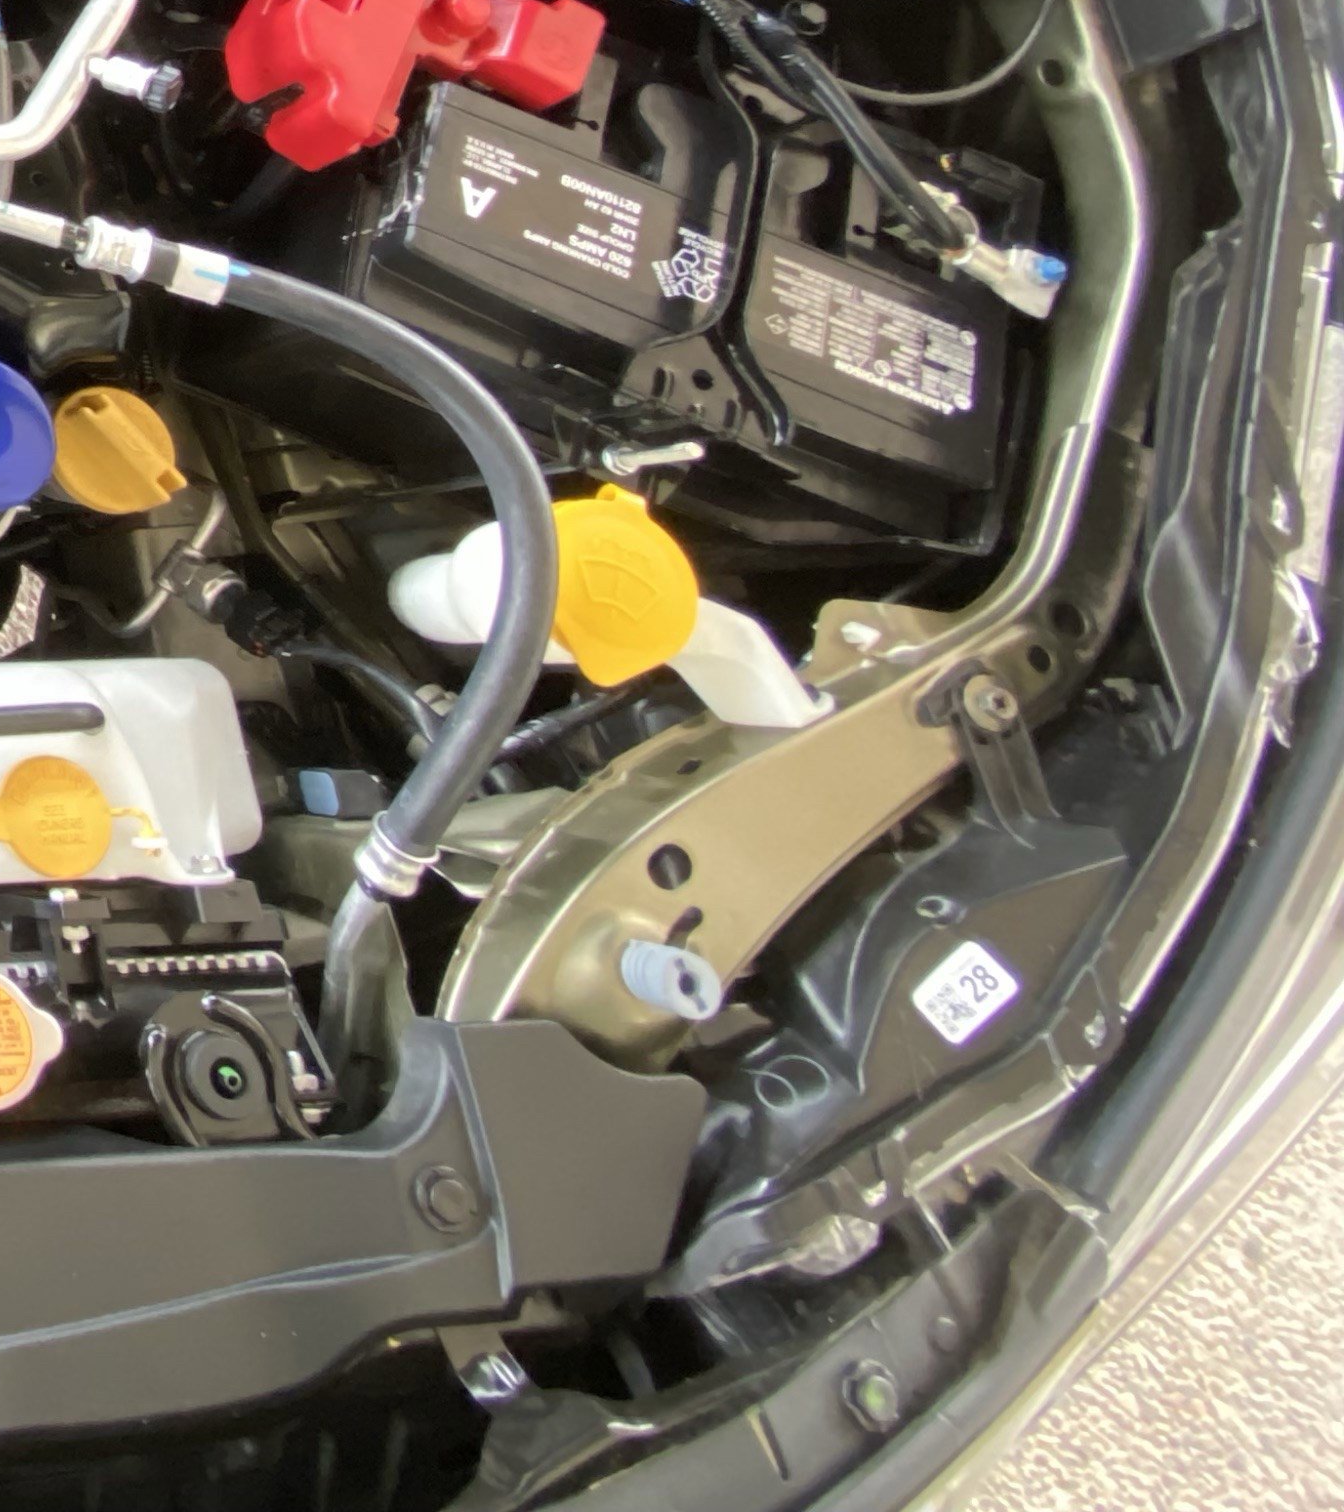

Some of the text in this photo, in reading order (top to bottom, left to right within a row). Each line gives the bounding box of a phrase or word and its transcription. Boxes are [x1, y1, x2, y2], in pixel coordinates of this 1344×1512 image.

[460, 175, 497, 219] A
[559, 173, 641, 215] 82110AN00B
[522, 229, 551, 246] AMPS
[608, 222, 637, 241] LN2
[567, 234, 632, 267] 620 AMPS
[959, 964, 1000, 1004] 28
